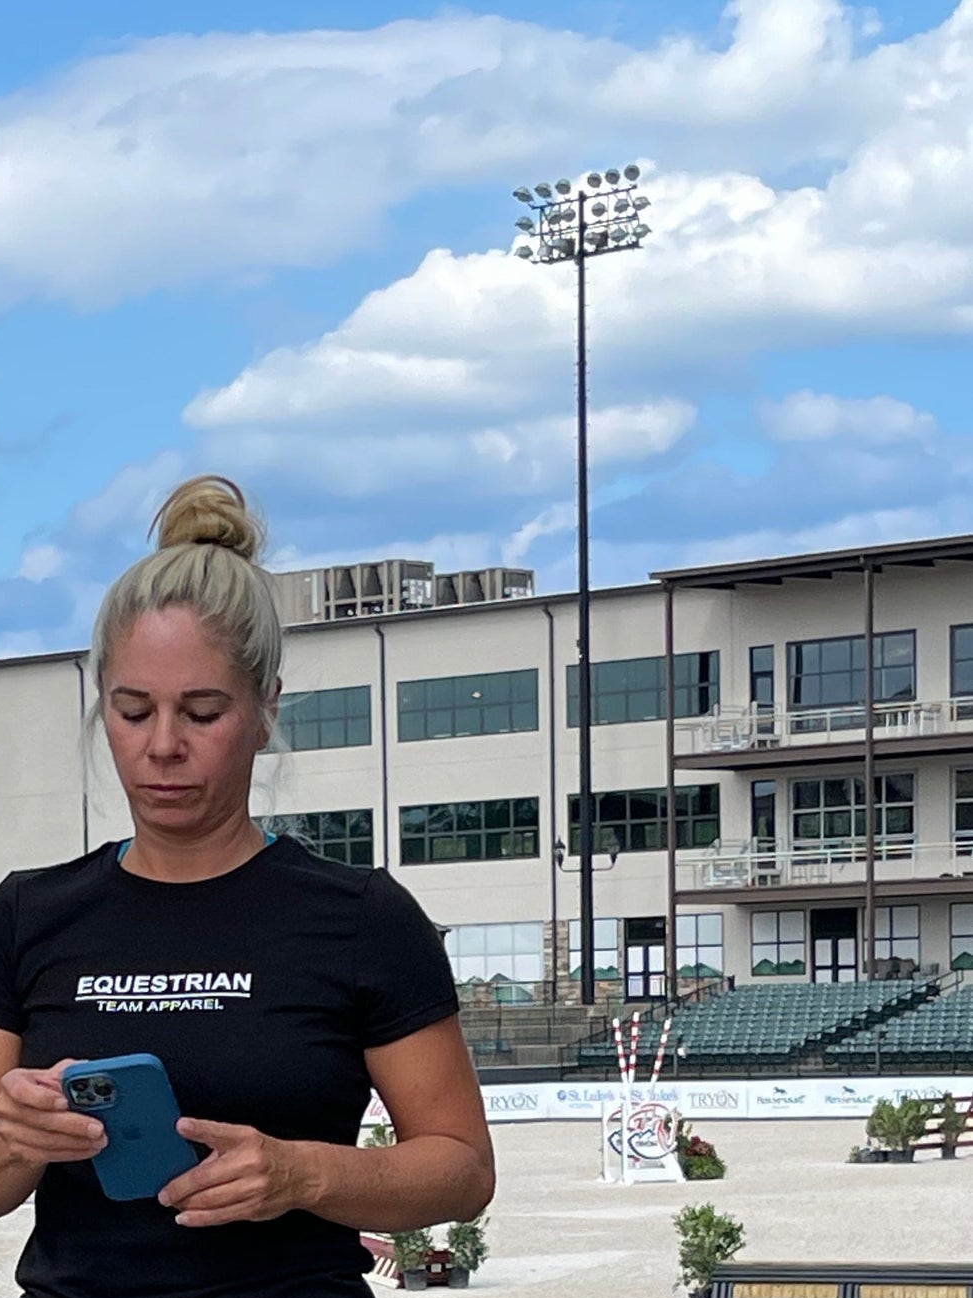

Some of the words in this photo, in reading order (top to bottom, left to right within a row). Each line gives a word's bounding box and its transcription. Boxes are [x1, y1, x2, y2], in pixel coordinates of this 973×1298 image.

[77, 972, 252, 994] EQUESTRIAN
[97, 1000, 143, 1012] TEAM
[146, 999, 224, 1012] APPAREL
[688, 1091, 739, 1106] TRYON
